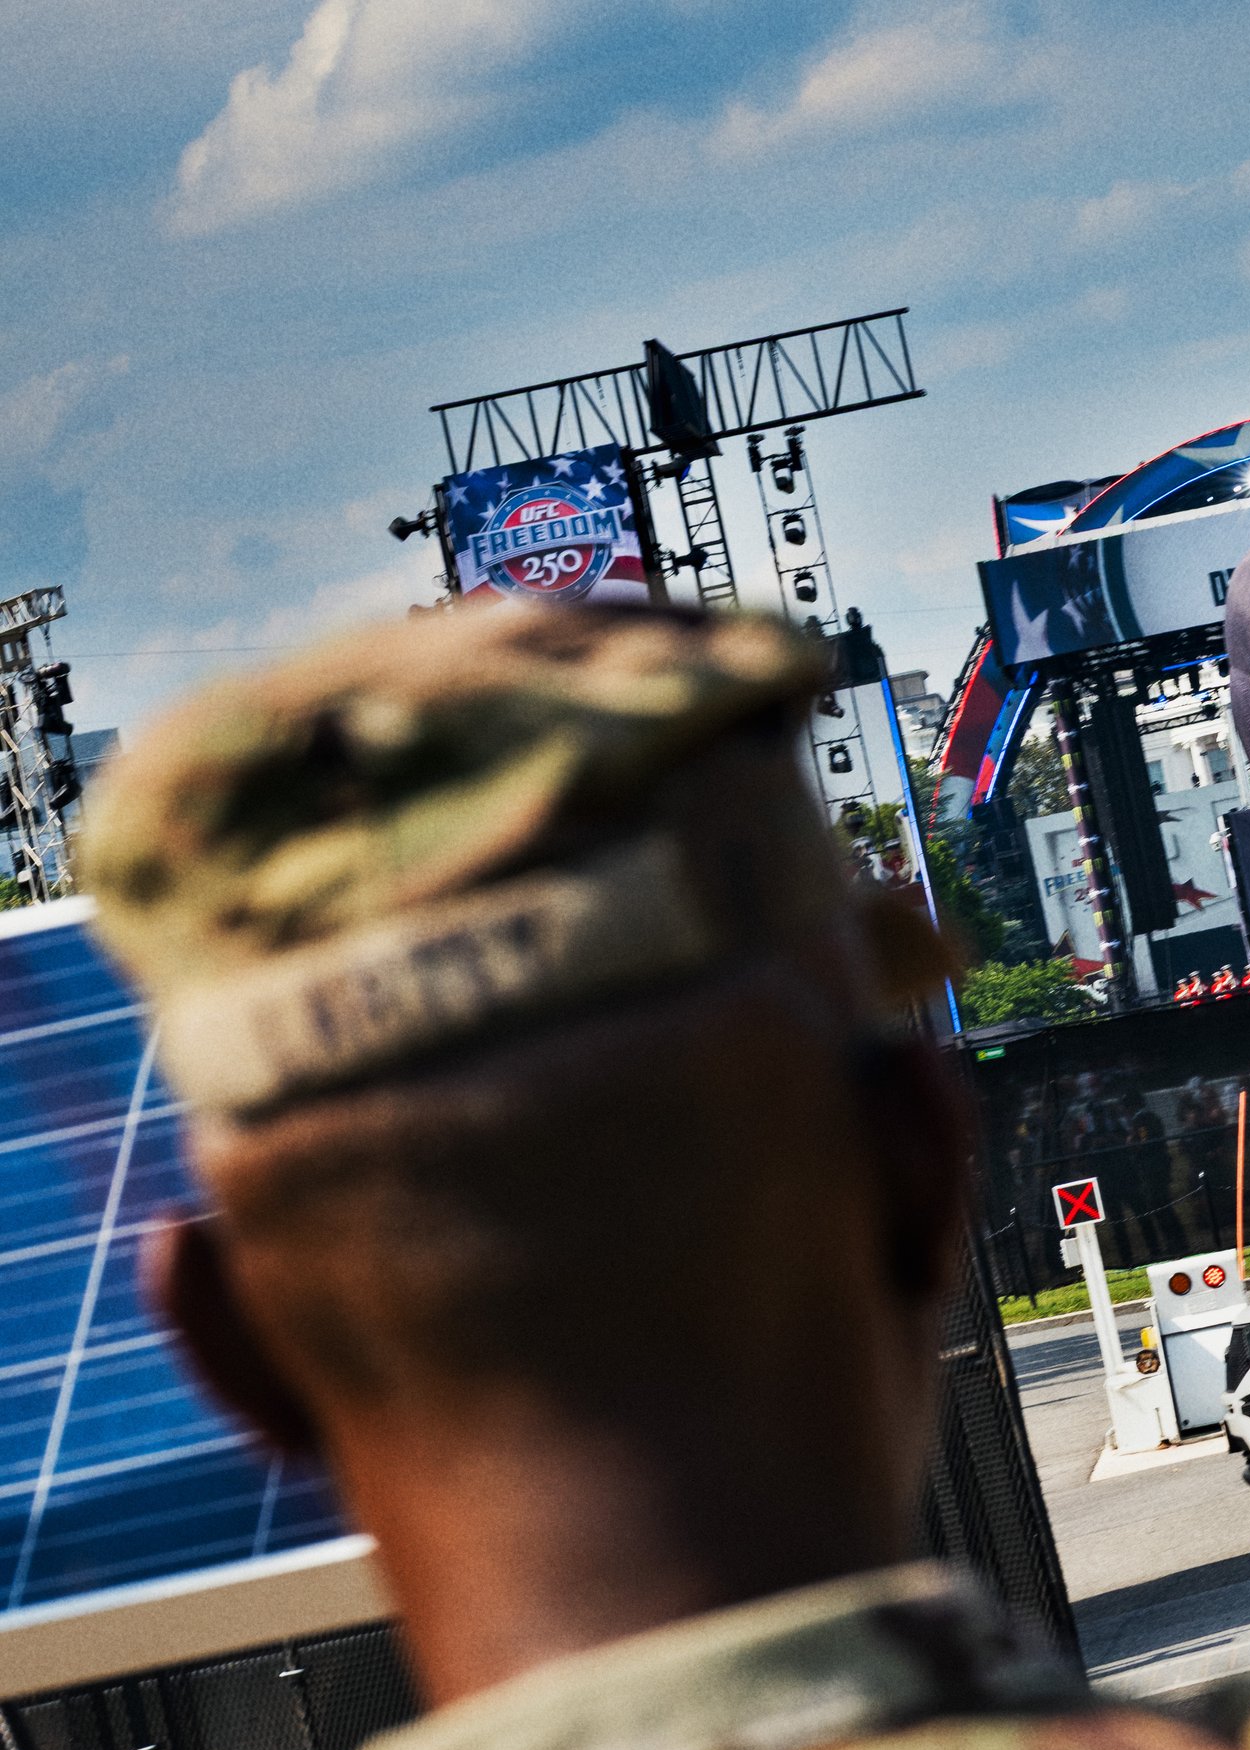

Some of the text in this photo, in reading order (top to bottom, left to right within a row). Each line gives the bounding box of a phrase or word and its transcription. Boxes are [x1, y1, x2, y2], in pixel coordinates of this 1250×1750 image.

[519, 501, 561, 524] UFC
[471, 507, 620, 571] FREEDOM
[521, 549, 583, 587] 250
